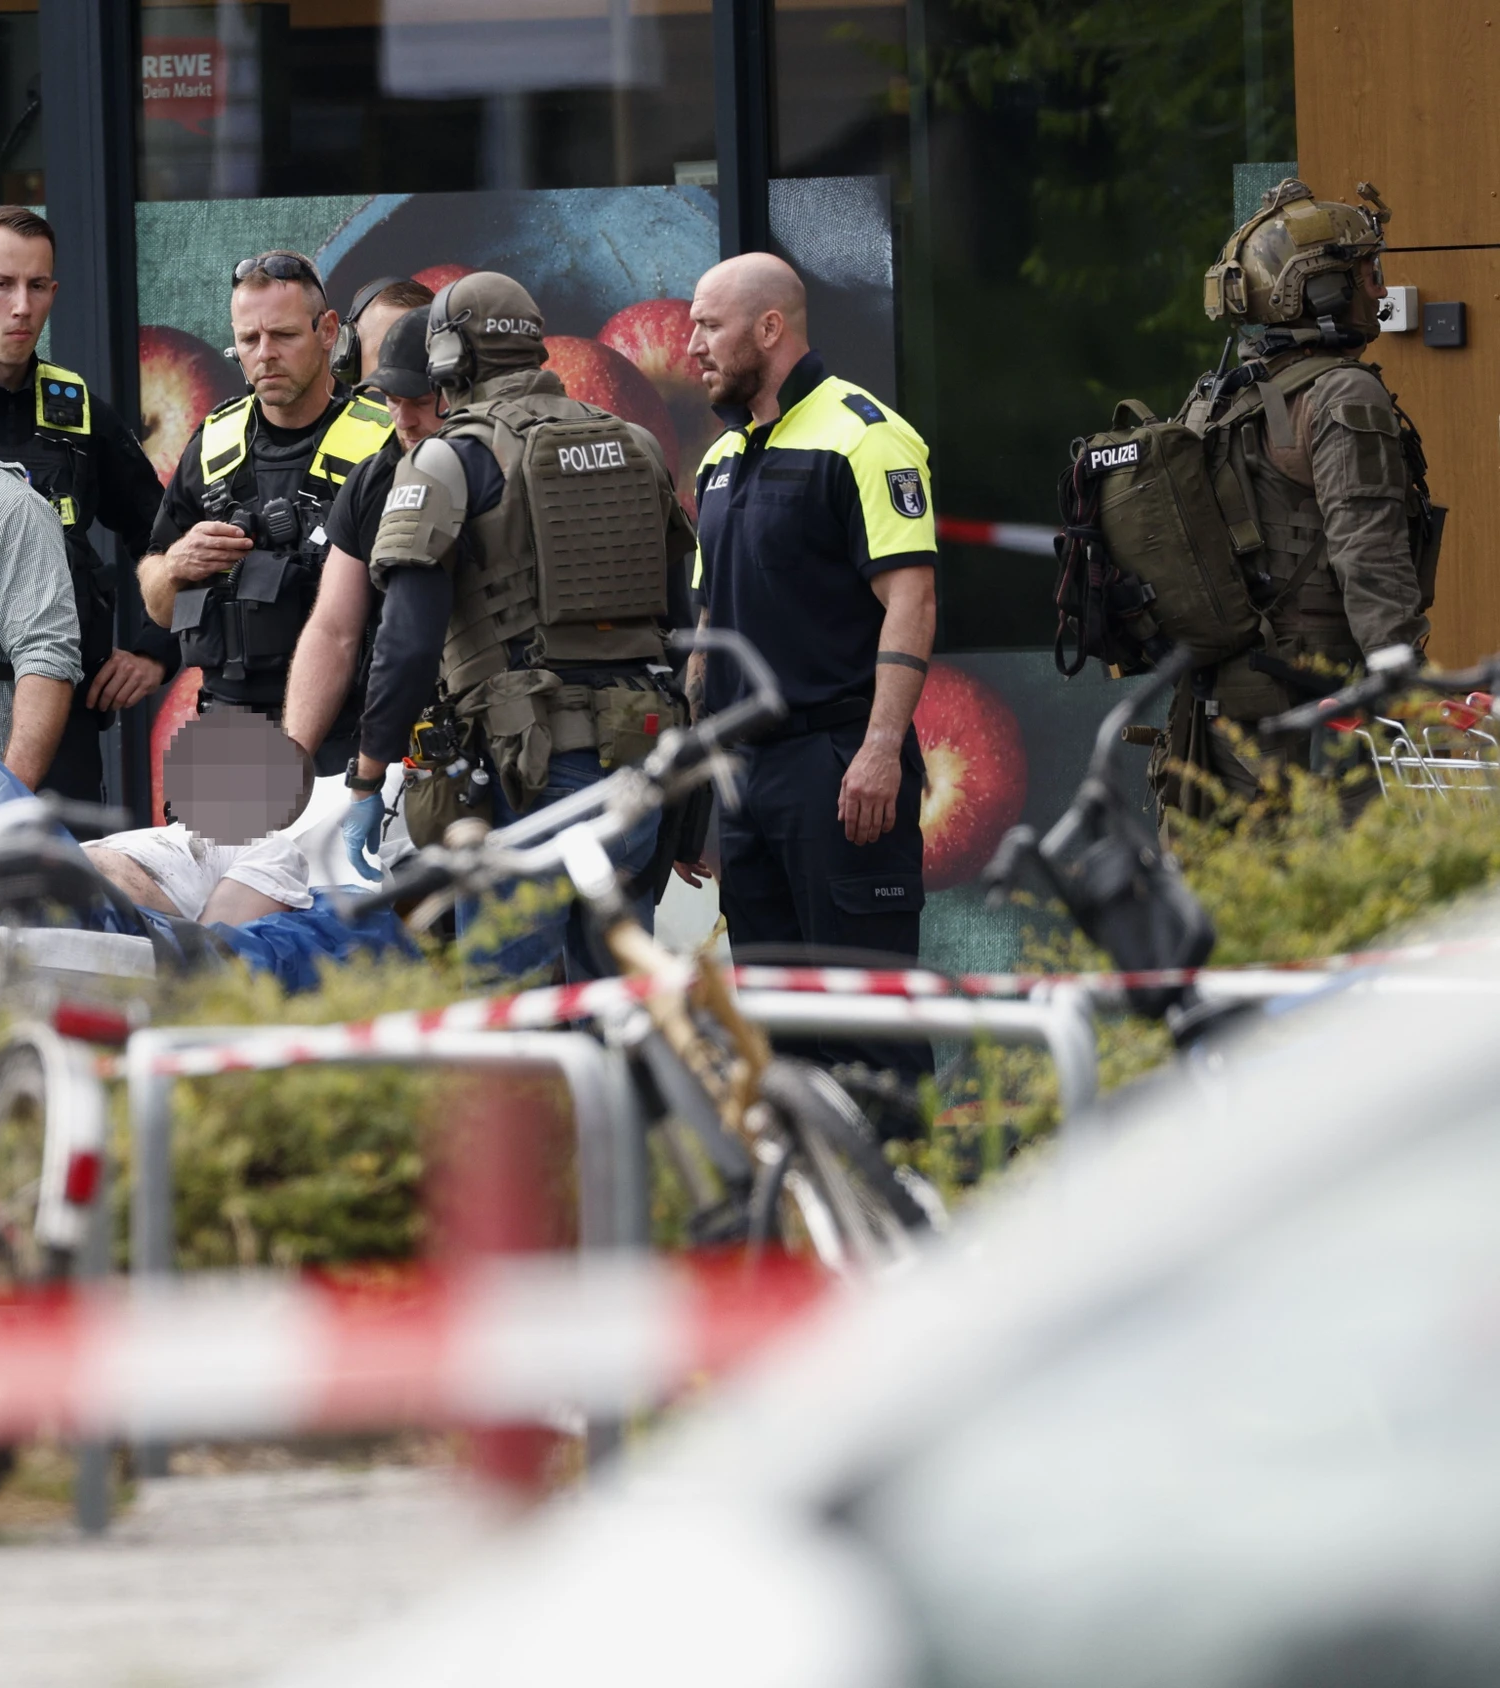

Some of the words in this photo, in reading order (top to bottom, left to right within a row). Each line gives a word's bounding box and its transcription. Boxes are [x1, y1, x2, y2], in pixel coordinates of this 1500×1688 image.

[142, 54, 212, 78] REWE
[143, 84, 170, 99] Dein
[173, 82, 212, 98] Markt
[558, 441, 626, 472] POLIZEI
[1091, 443, 1138, 469] POLIZEI
[381, 485, 426, 518] LIZEI
[874, 887, 905, 897] POLIZEI
